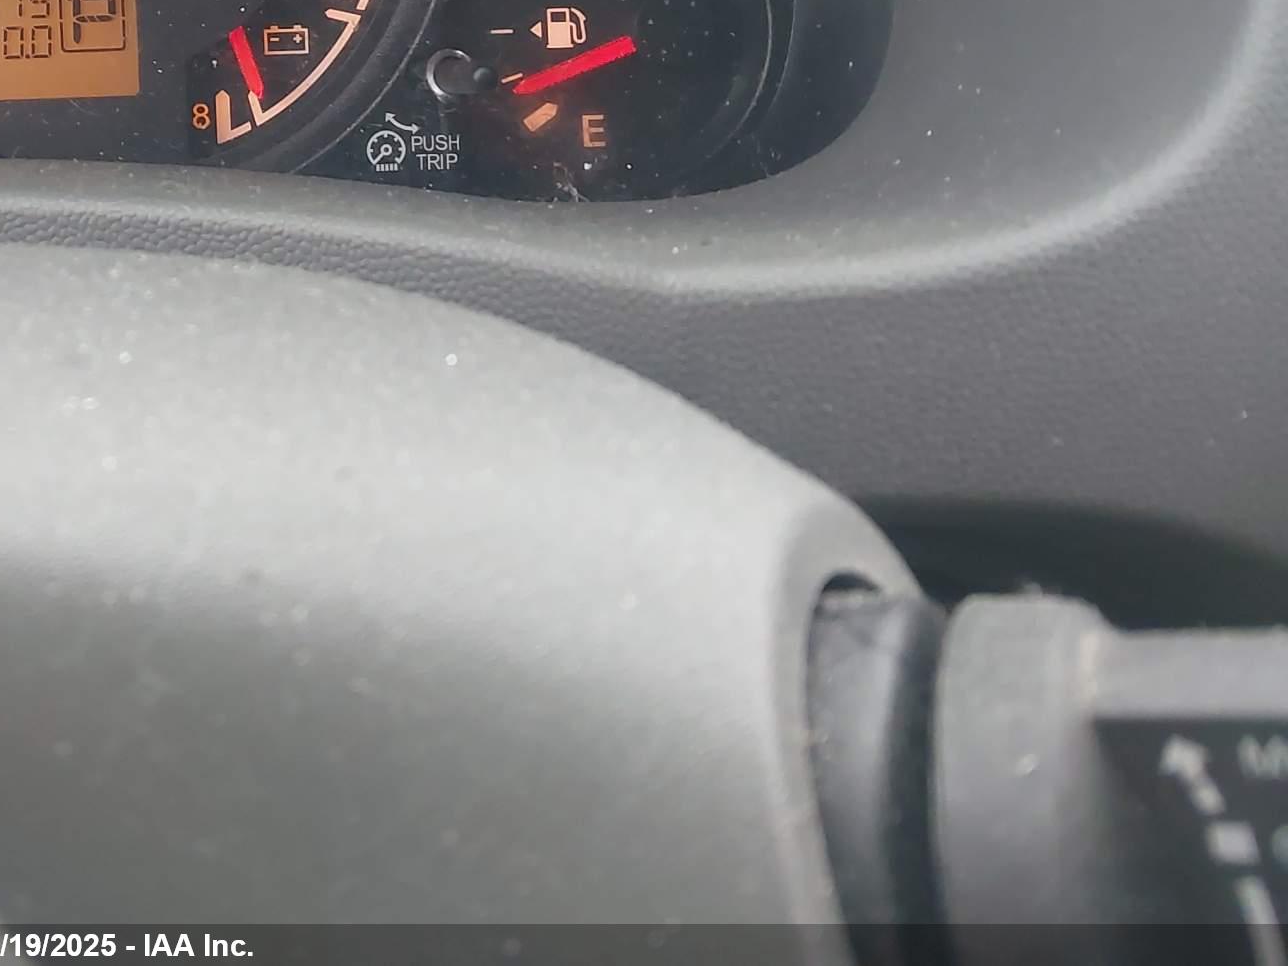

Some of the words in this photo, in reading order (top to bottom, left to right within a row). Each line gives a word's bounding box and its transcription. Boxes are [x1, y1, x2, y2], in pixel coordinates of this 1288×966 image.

[2, 24, 52, 59] 0.0
[192, 103, 211, 130] 8
[410, 134, 461, 152] PUSH
[581, 114, 606, 148] E
[414, 153, 459, 171] TRIP
